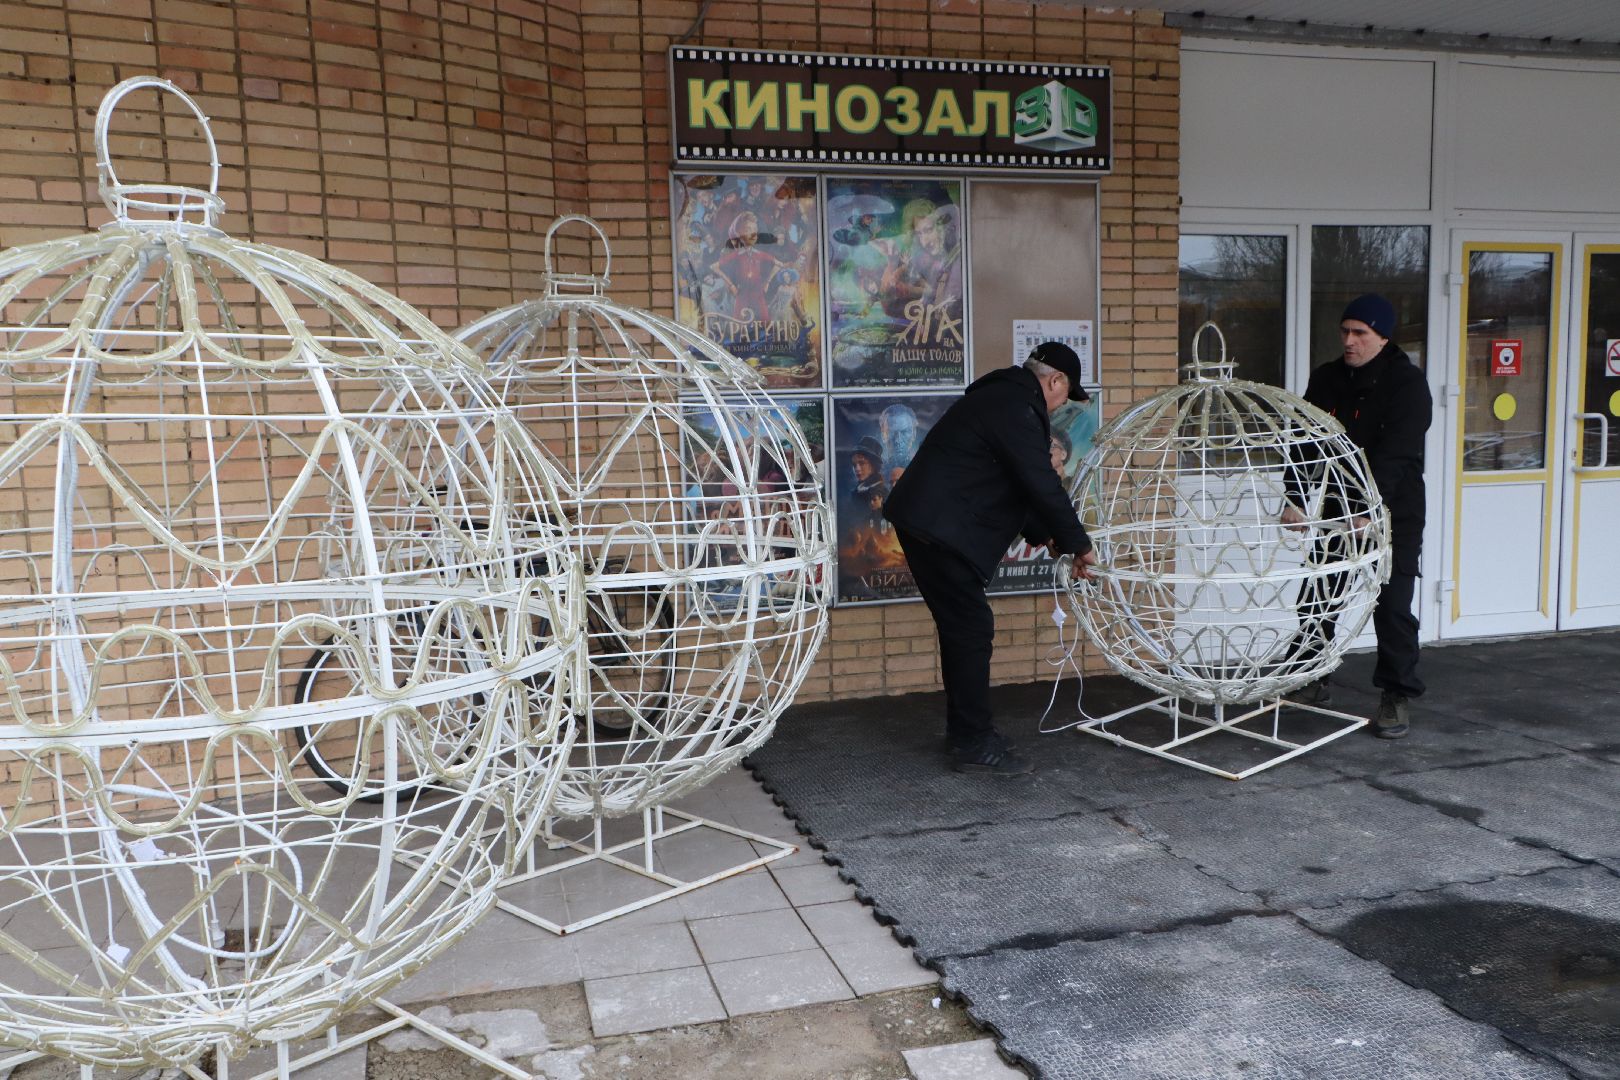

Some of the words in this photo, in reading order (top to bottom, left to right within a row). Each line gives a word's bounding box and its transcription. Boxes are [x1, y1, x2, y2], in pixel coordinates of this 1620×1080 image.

[688, 78, 1011, 138] КИНОЗАЛ
[1014, 85, 1098, 139] 3D
[698, 307, 800, 343] БУРАТИНО
[896, 296, 963, 345] ЯГА
[943, 337, 954, 347] НА
[892, 348, 926, 363] НАШУ
[929, 348, 963, 363] ГОЛОВ
[998, 567, 1004, 577] В
[1006, 566, 1028, 577] КИНО
[1030, 565, 1036, 576] С
[1037, 564, 1049, 575] 27
